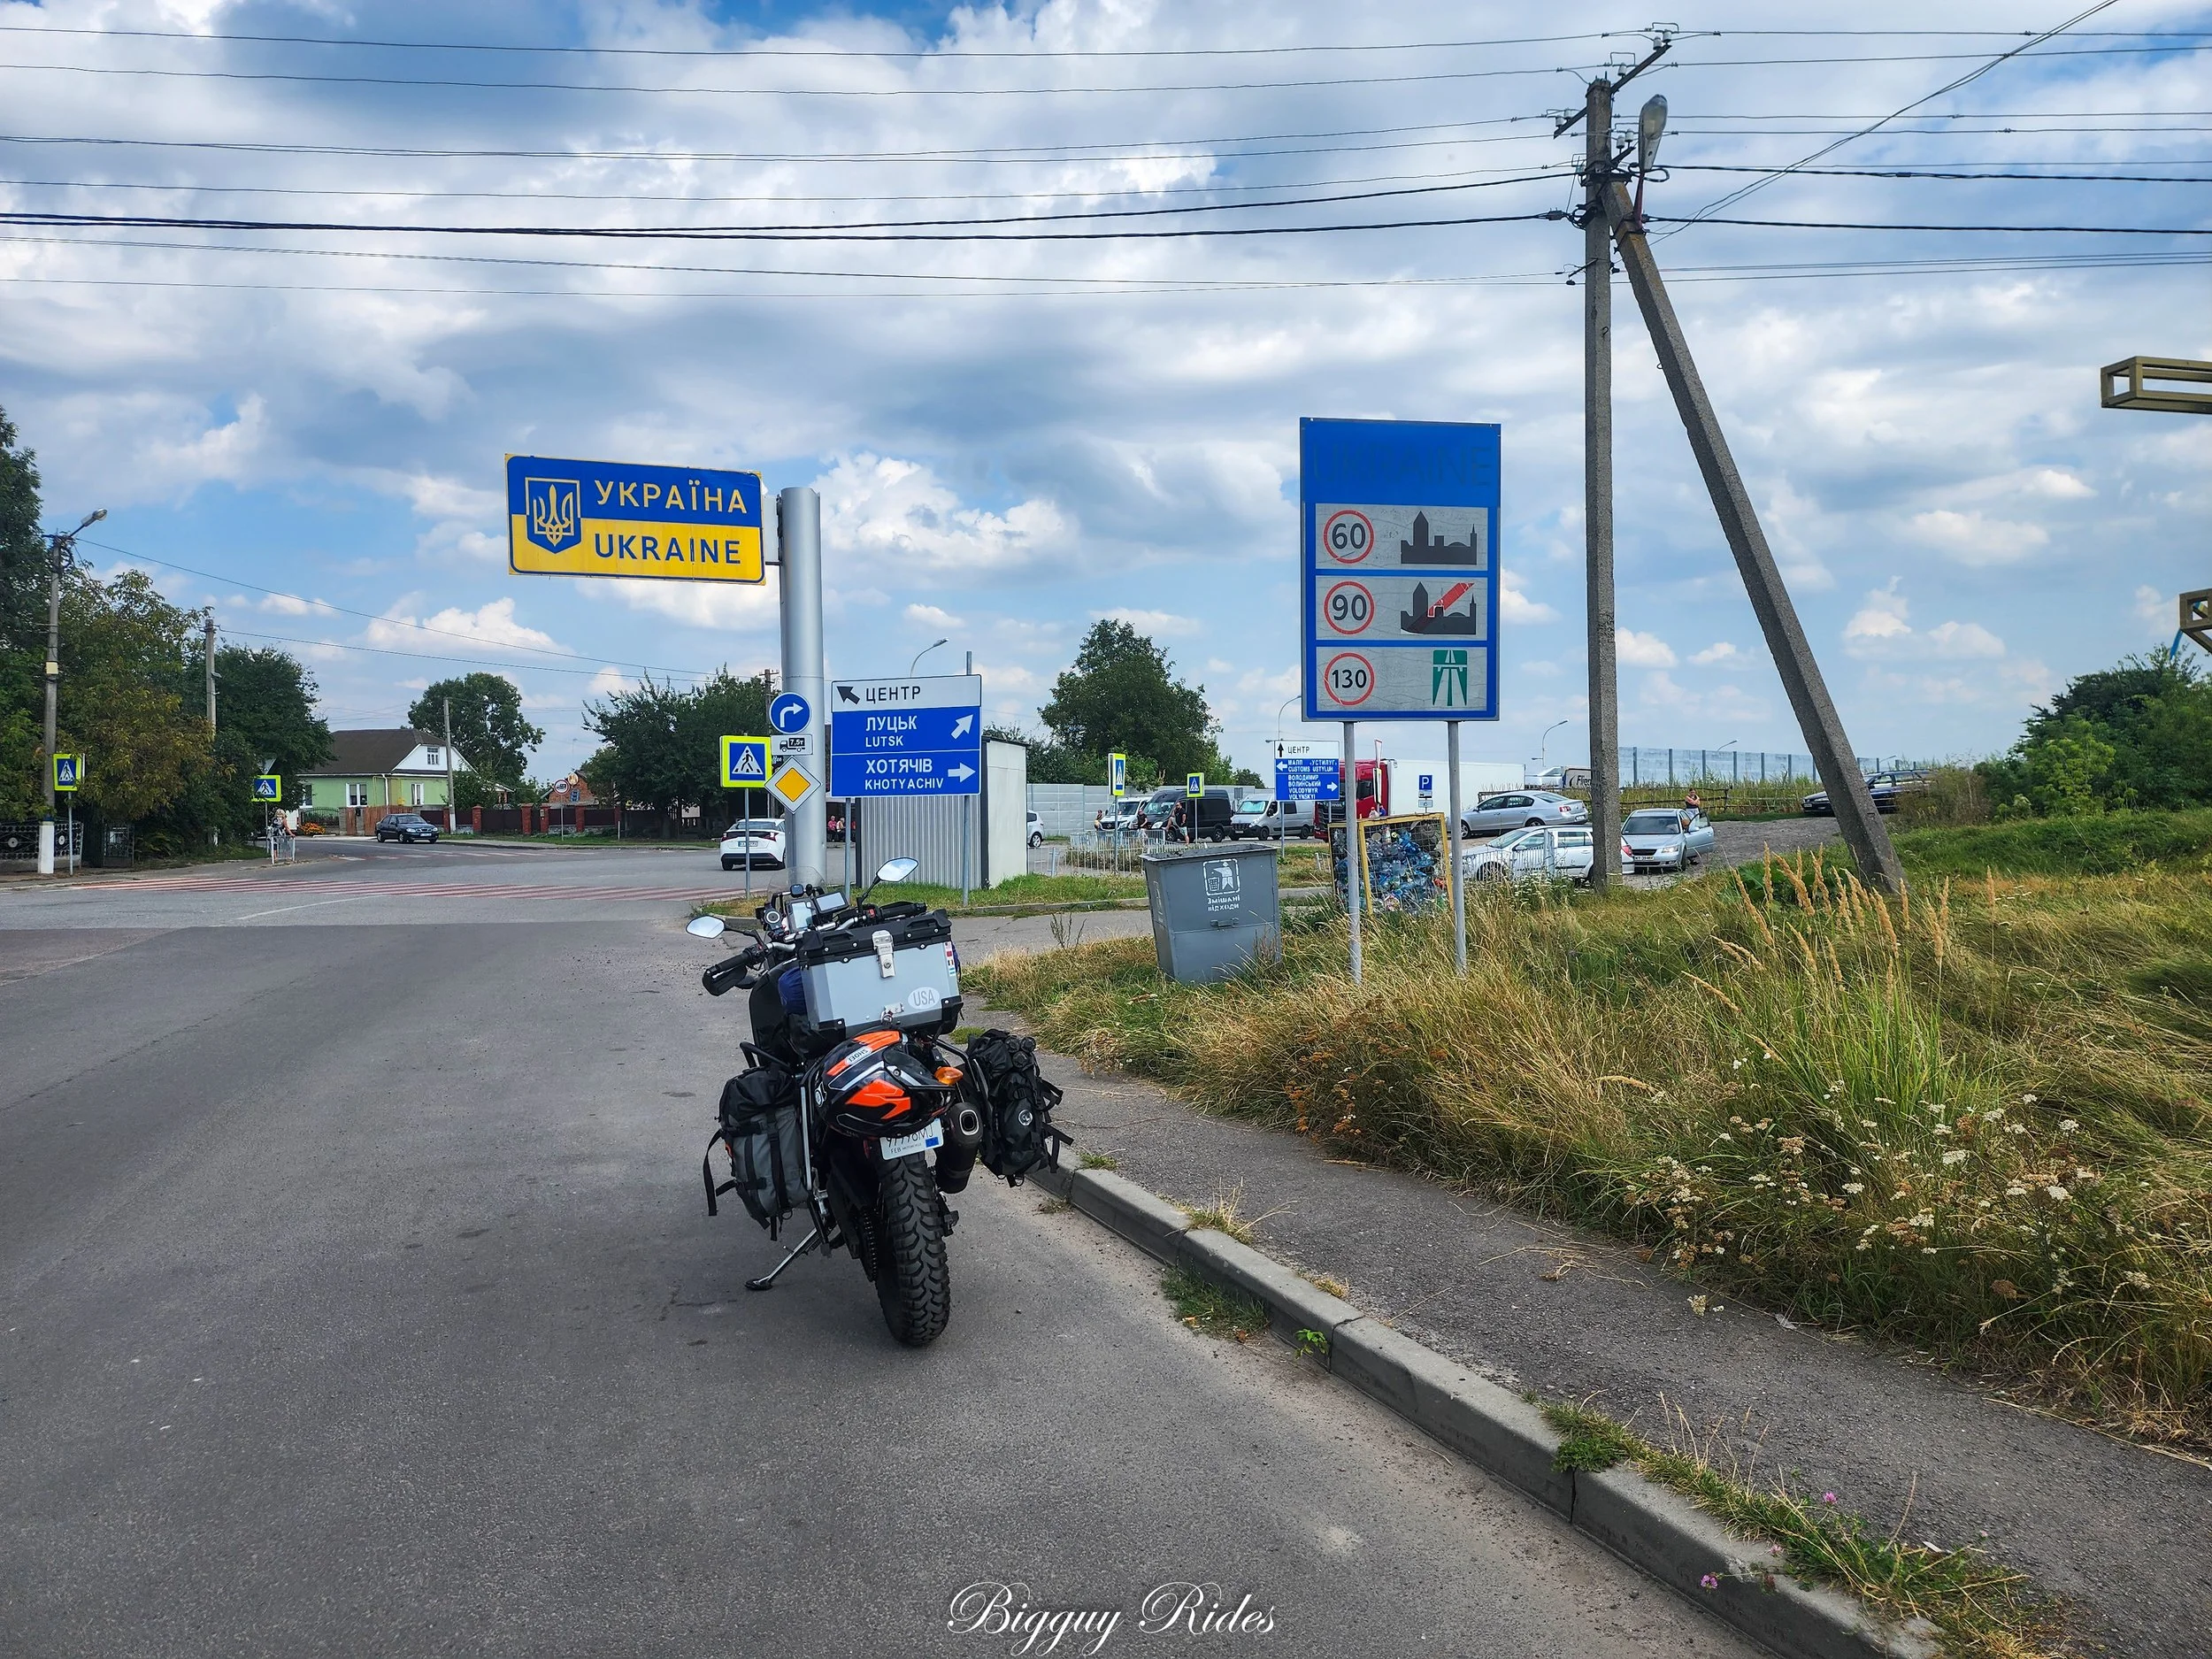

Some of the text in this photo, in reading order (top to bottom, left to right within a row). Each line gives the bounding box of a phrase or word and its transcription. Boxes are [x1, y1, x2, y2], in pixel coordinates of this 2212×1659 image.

[595, 479, 748, 514] УКРАЇНА
[1332, 522, 1366, 549] 60
[595, 533, 741, 565] UKRAINE
[1332, 594, 1367, 621] 90
[1331, 668, 1367, 689] 130
[865, 686, 921, 704] ЦЕНТР
[865, 715, 918, 733] ЛУЦЬК
[865, 735, 903, 748] LUTSK
[866, 758, 933, 774] ХОТЯЧІВ
[864, 778, 944, 790] KHOTYACHIV
[912, 989, 935, 1007] USA
[849, 1048, 869, 1063] SHOEI
